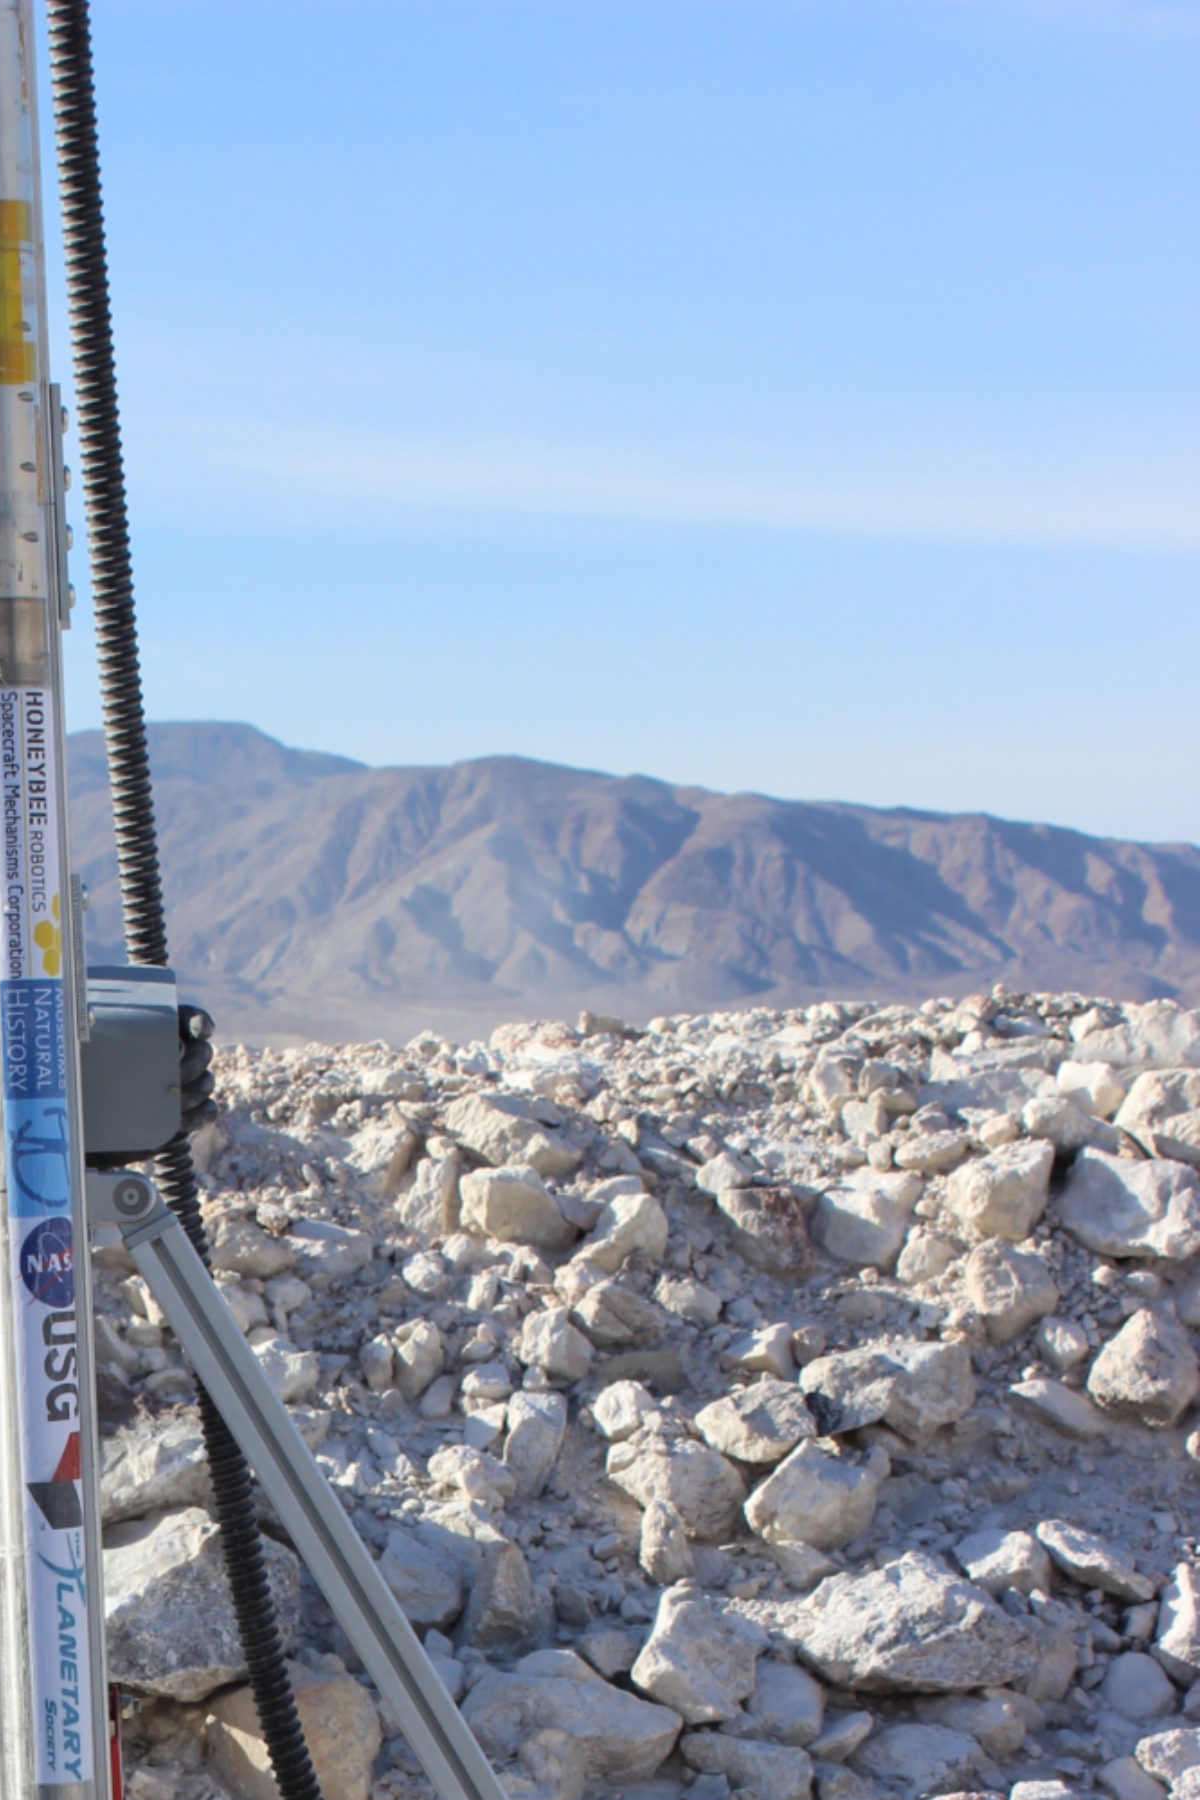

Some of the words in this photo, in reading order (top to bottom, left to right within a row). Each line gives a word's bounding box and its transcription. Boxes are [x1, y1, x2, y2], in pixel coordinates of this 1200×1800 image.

[1, 691, 20, 779] Spacecraft
[25, 691, 48, 826] HONEYBEE
[4, 785, 22, 880] Mechanisms
[29, 830, 47, 913] ROBOTICS
[4, 884, 26, 979] Corporation
[5, 988, 29, 1092] HISTORY
[34, 988, 52, 1091] NATURAL
[26, 1252, 72, 1273] NAS
[42, 1311, 79, 1422] USG
[45, 1698, 57, 1773] SOCIETY
